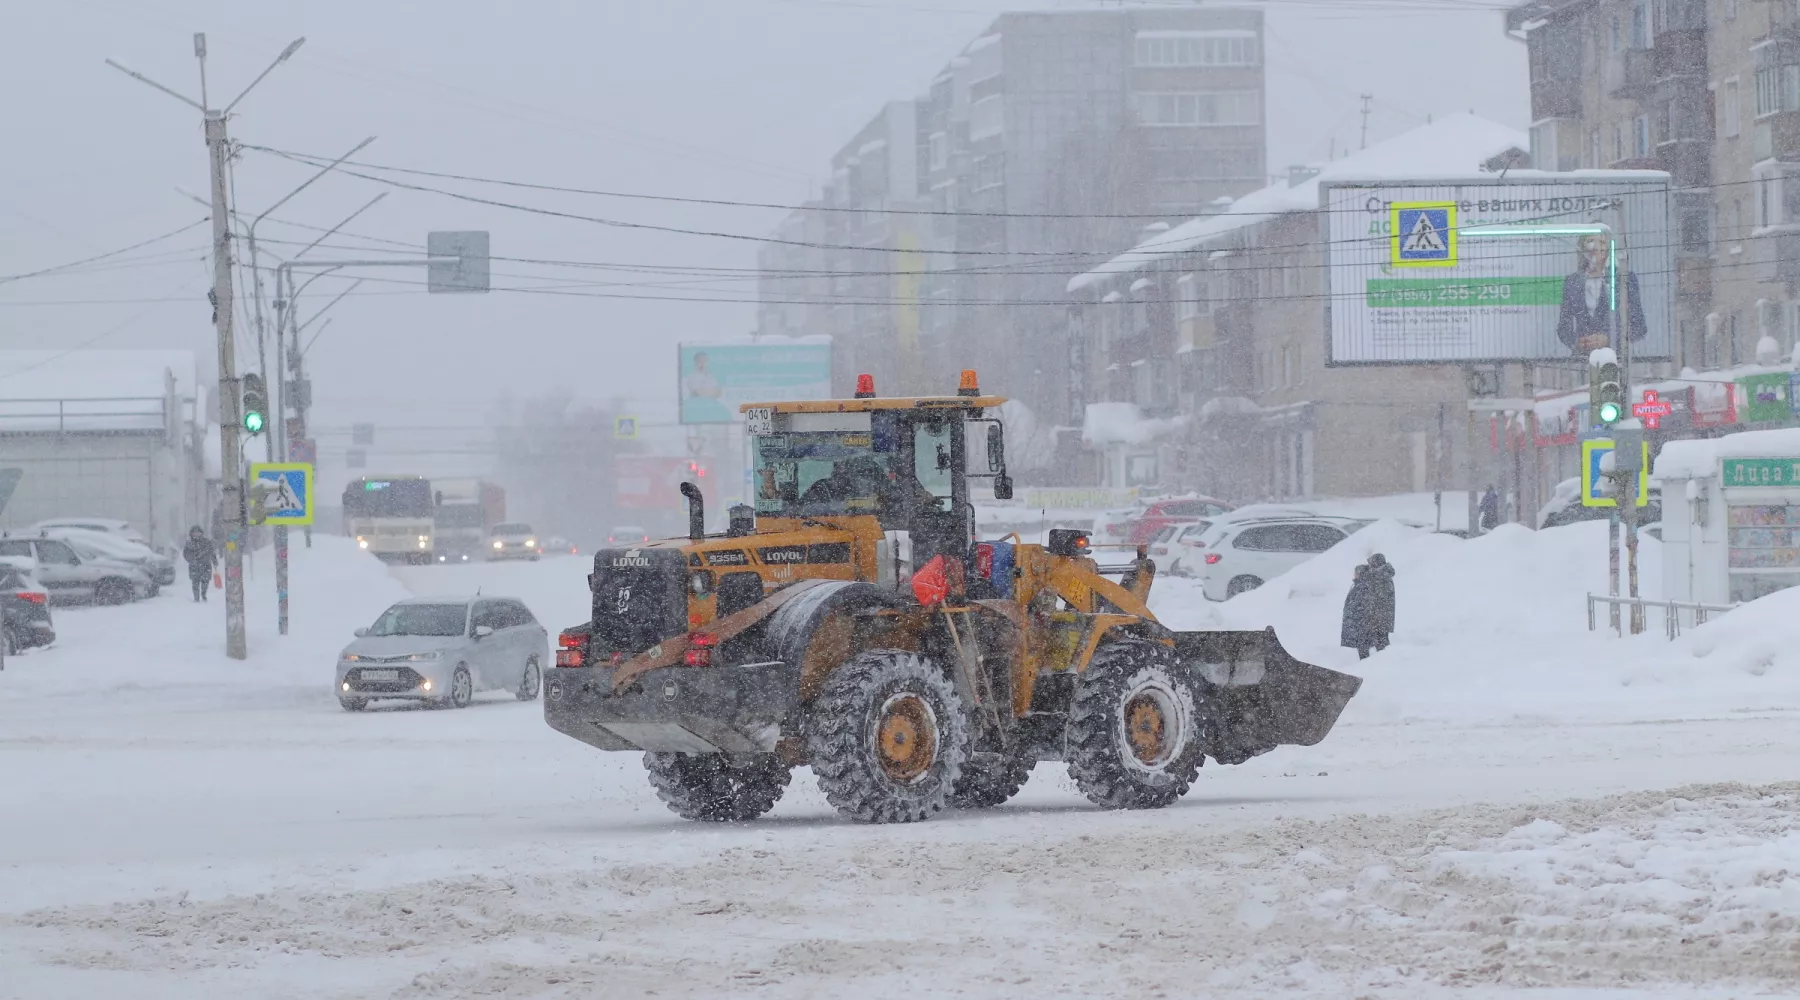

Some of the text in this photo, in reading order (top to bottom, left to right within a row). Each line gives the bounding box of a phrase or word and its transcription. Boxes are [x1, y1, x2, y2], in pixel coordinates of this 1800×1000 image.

[1478, 199, 1542, 212] ваших
[1437, 284, 1511, 300] 255-290
[748, 409, 769, 420] 0410
[762, 421, 770, 431] 22
[1027, 489, 1115, 509] ЯРМАРКА
[766, 551, 803, 561] LOVOL
[612, 557, 651, 567] LOVOL
